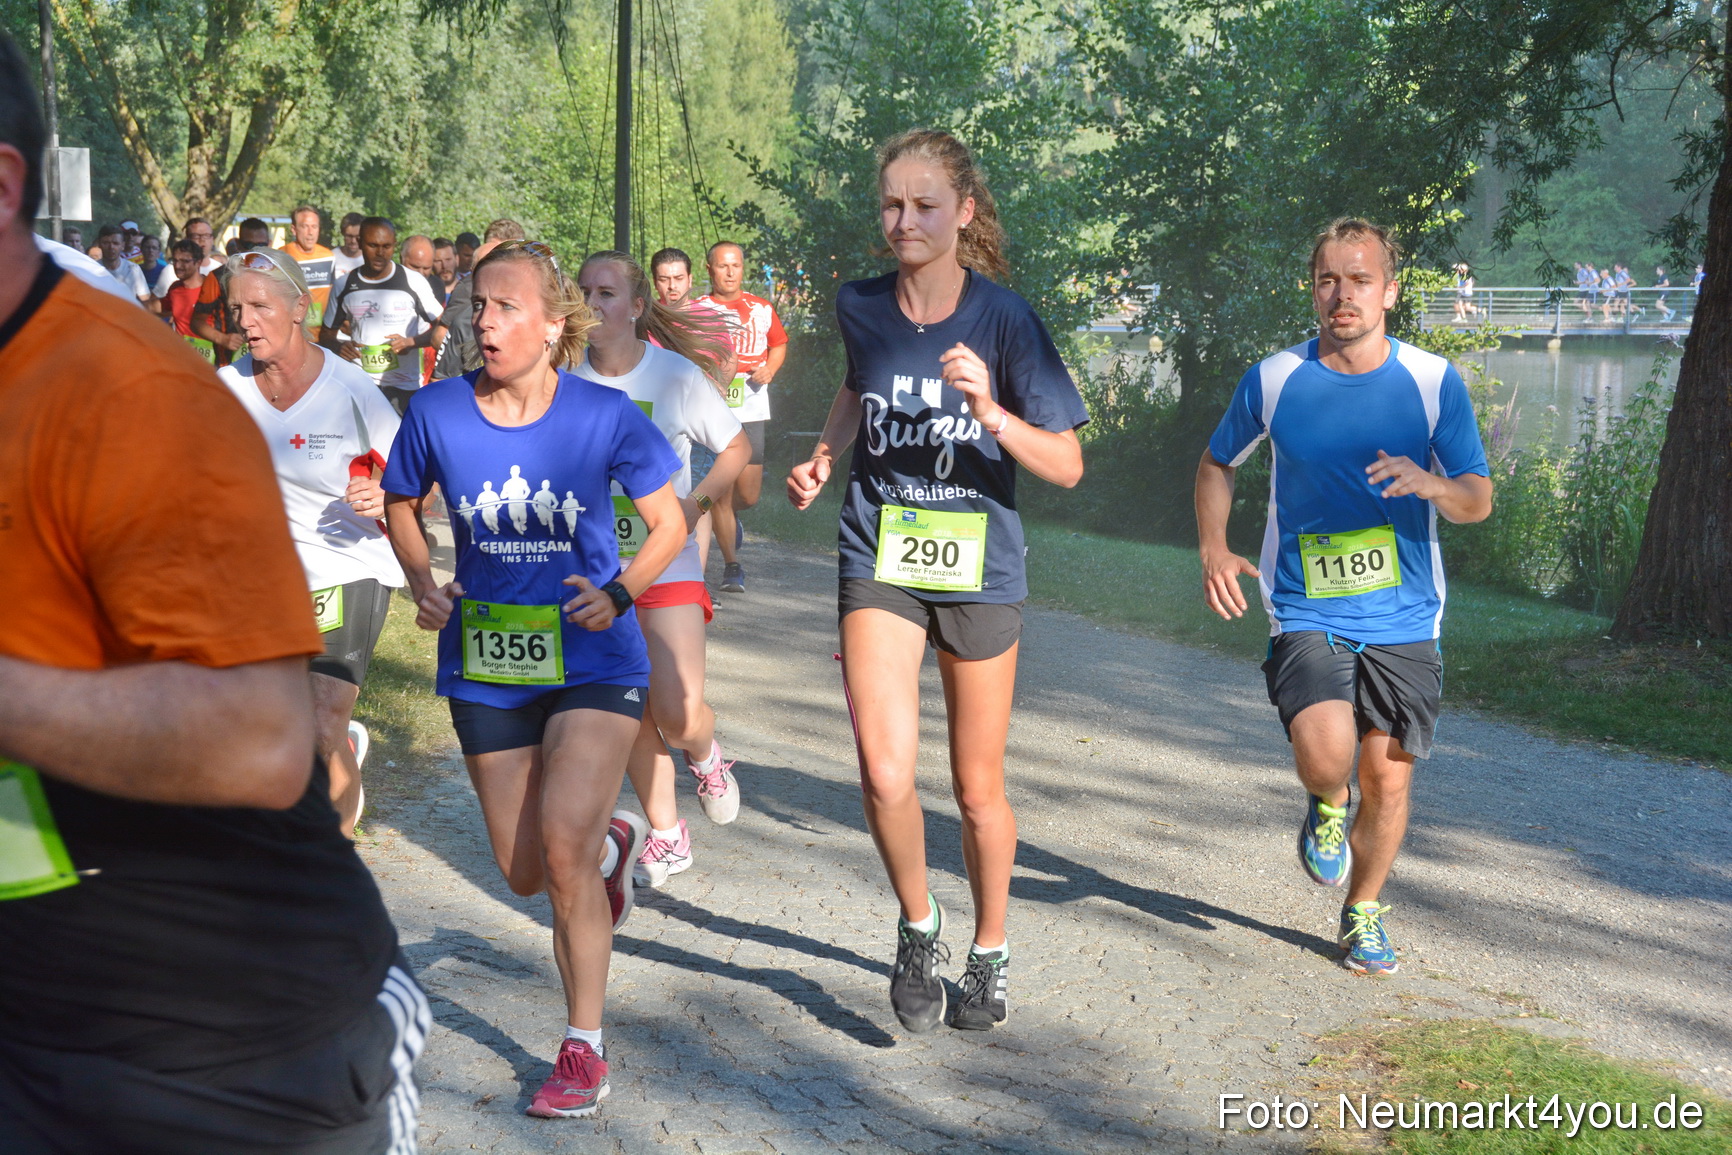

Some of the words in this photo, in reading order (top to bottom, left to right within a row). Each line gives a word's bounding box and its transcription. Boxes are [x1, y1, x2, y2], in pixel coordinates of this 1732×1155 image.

[364, 352, 393, 365] 1463
[861, 392, 981, 480] Burgis
[308, 452, 324, 460] Eva
[479, 541, 572, 554] GEMEINSAM
[900, 536, 960, 568] 290
[502, 555, 522, 563] INS
[525, 554, 550, 563] ZIEL
[1315, 549, 1384, 579] 1180
[897, 565, 922, 574] Lerzer
[923, 567, 962, 577] Franziska
[1329, 578, 1357, 586] Klutzny
[1358, 574, 1375, 582] Felix
[472, 629, 547, 662] 1356
[481, 660, 506, 670] Borger
[508, 662, 538, 672] Stephie
